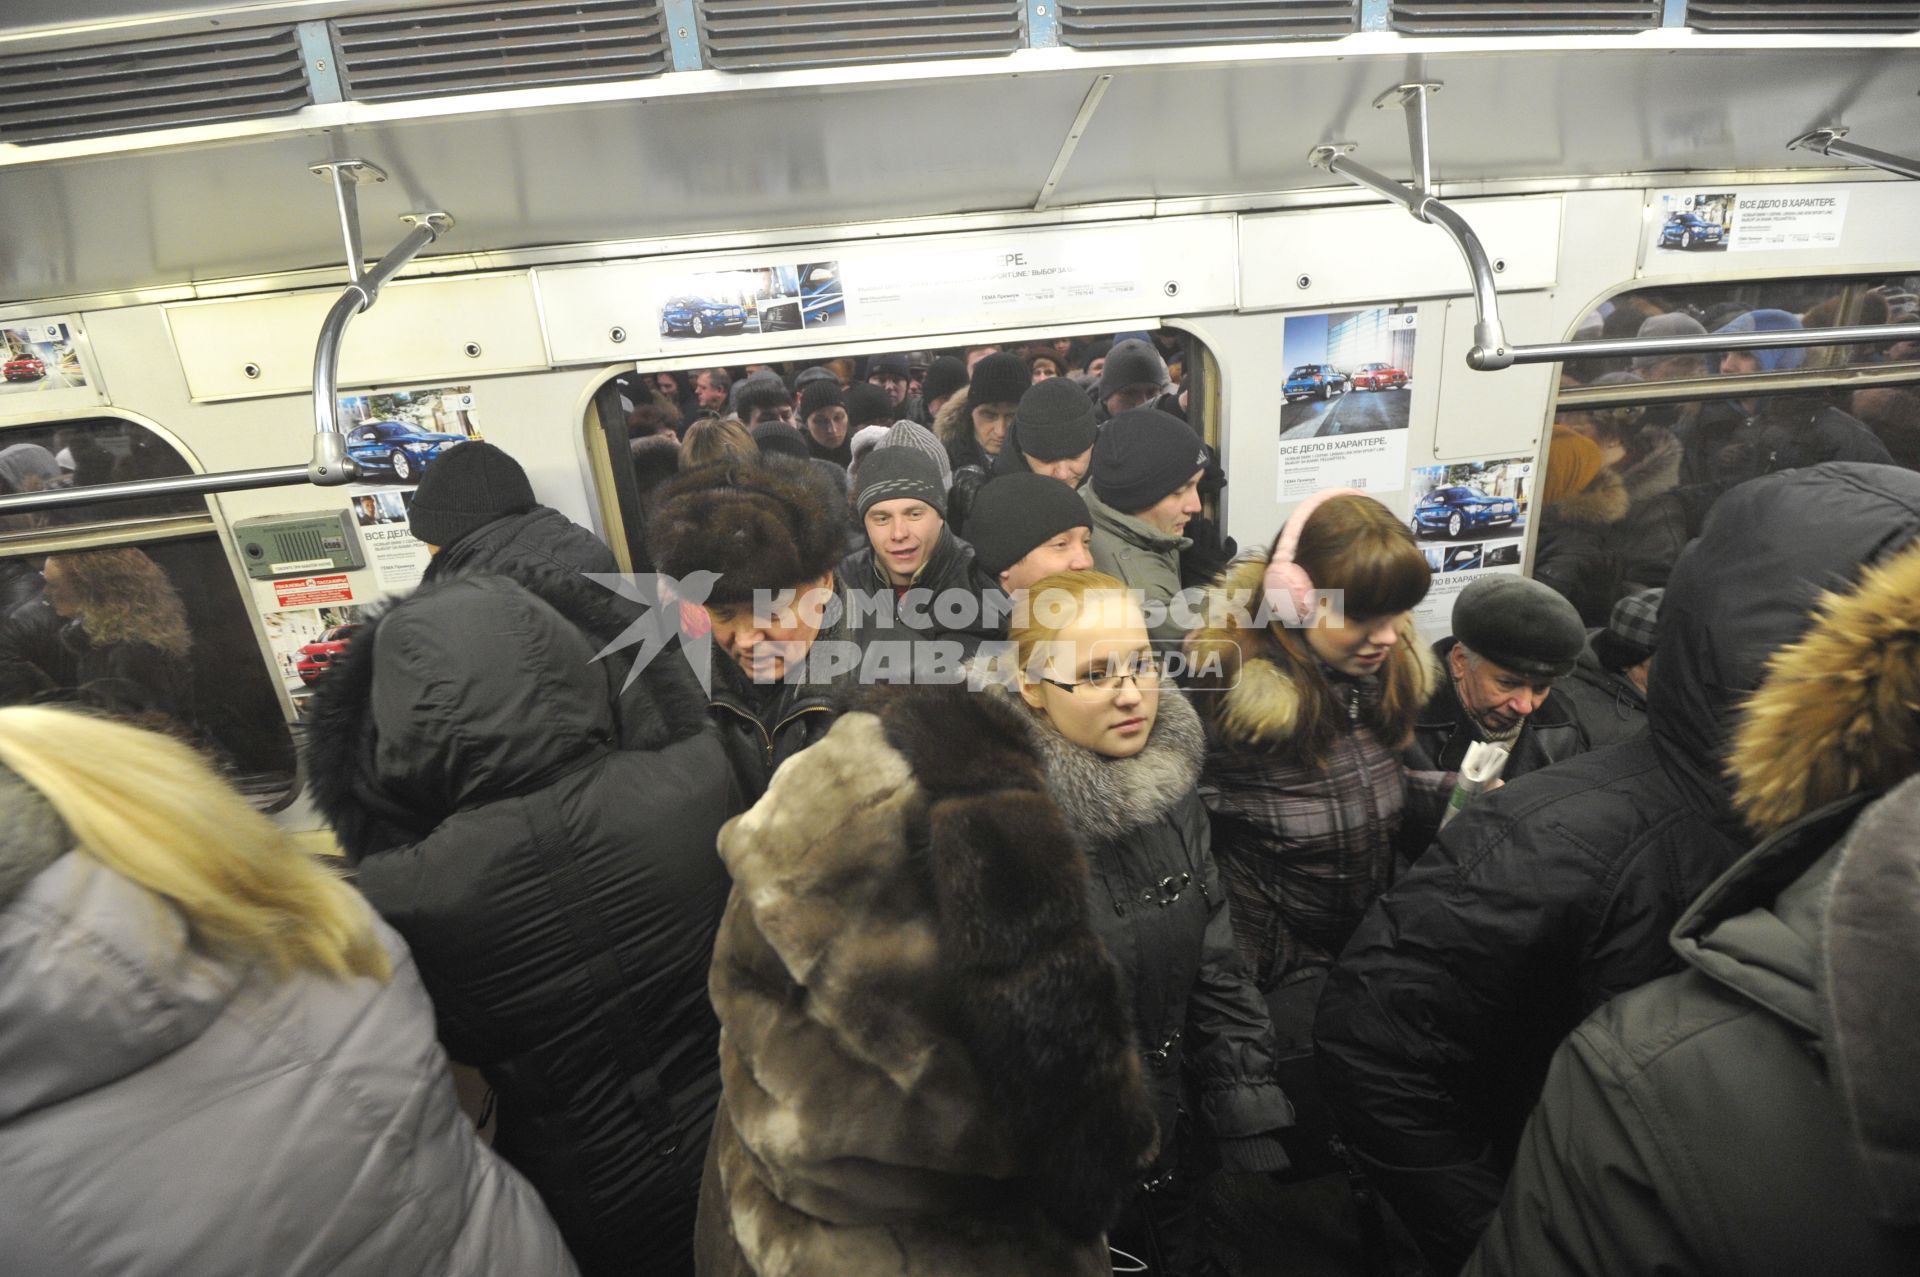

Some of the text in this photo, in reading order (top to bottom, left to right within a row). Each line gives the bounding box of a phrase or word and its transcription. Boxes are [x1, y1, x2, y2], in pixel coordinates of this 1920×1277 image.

[1740, 201, 1756, 209] ВСЕ
[1757, 200, 1781, 209] ДЕЛО
[1782, 199, 1787, 207] В
[1280, 437, 1387, 455] ВСЕ ДЕЛО В ХАРАКТЕРЕ.
[365, 531, 385, 541] ВСЕ
